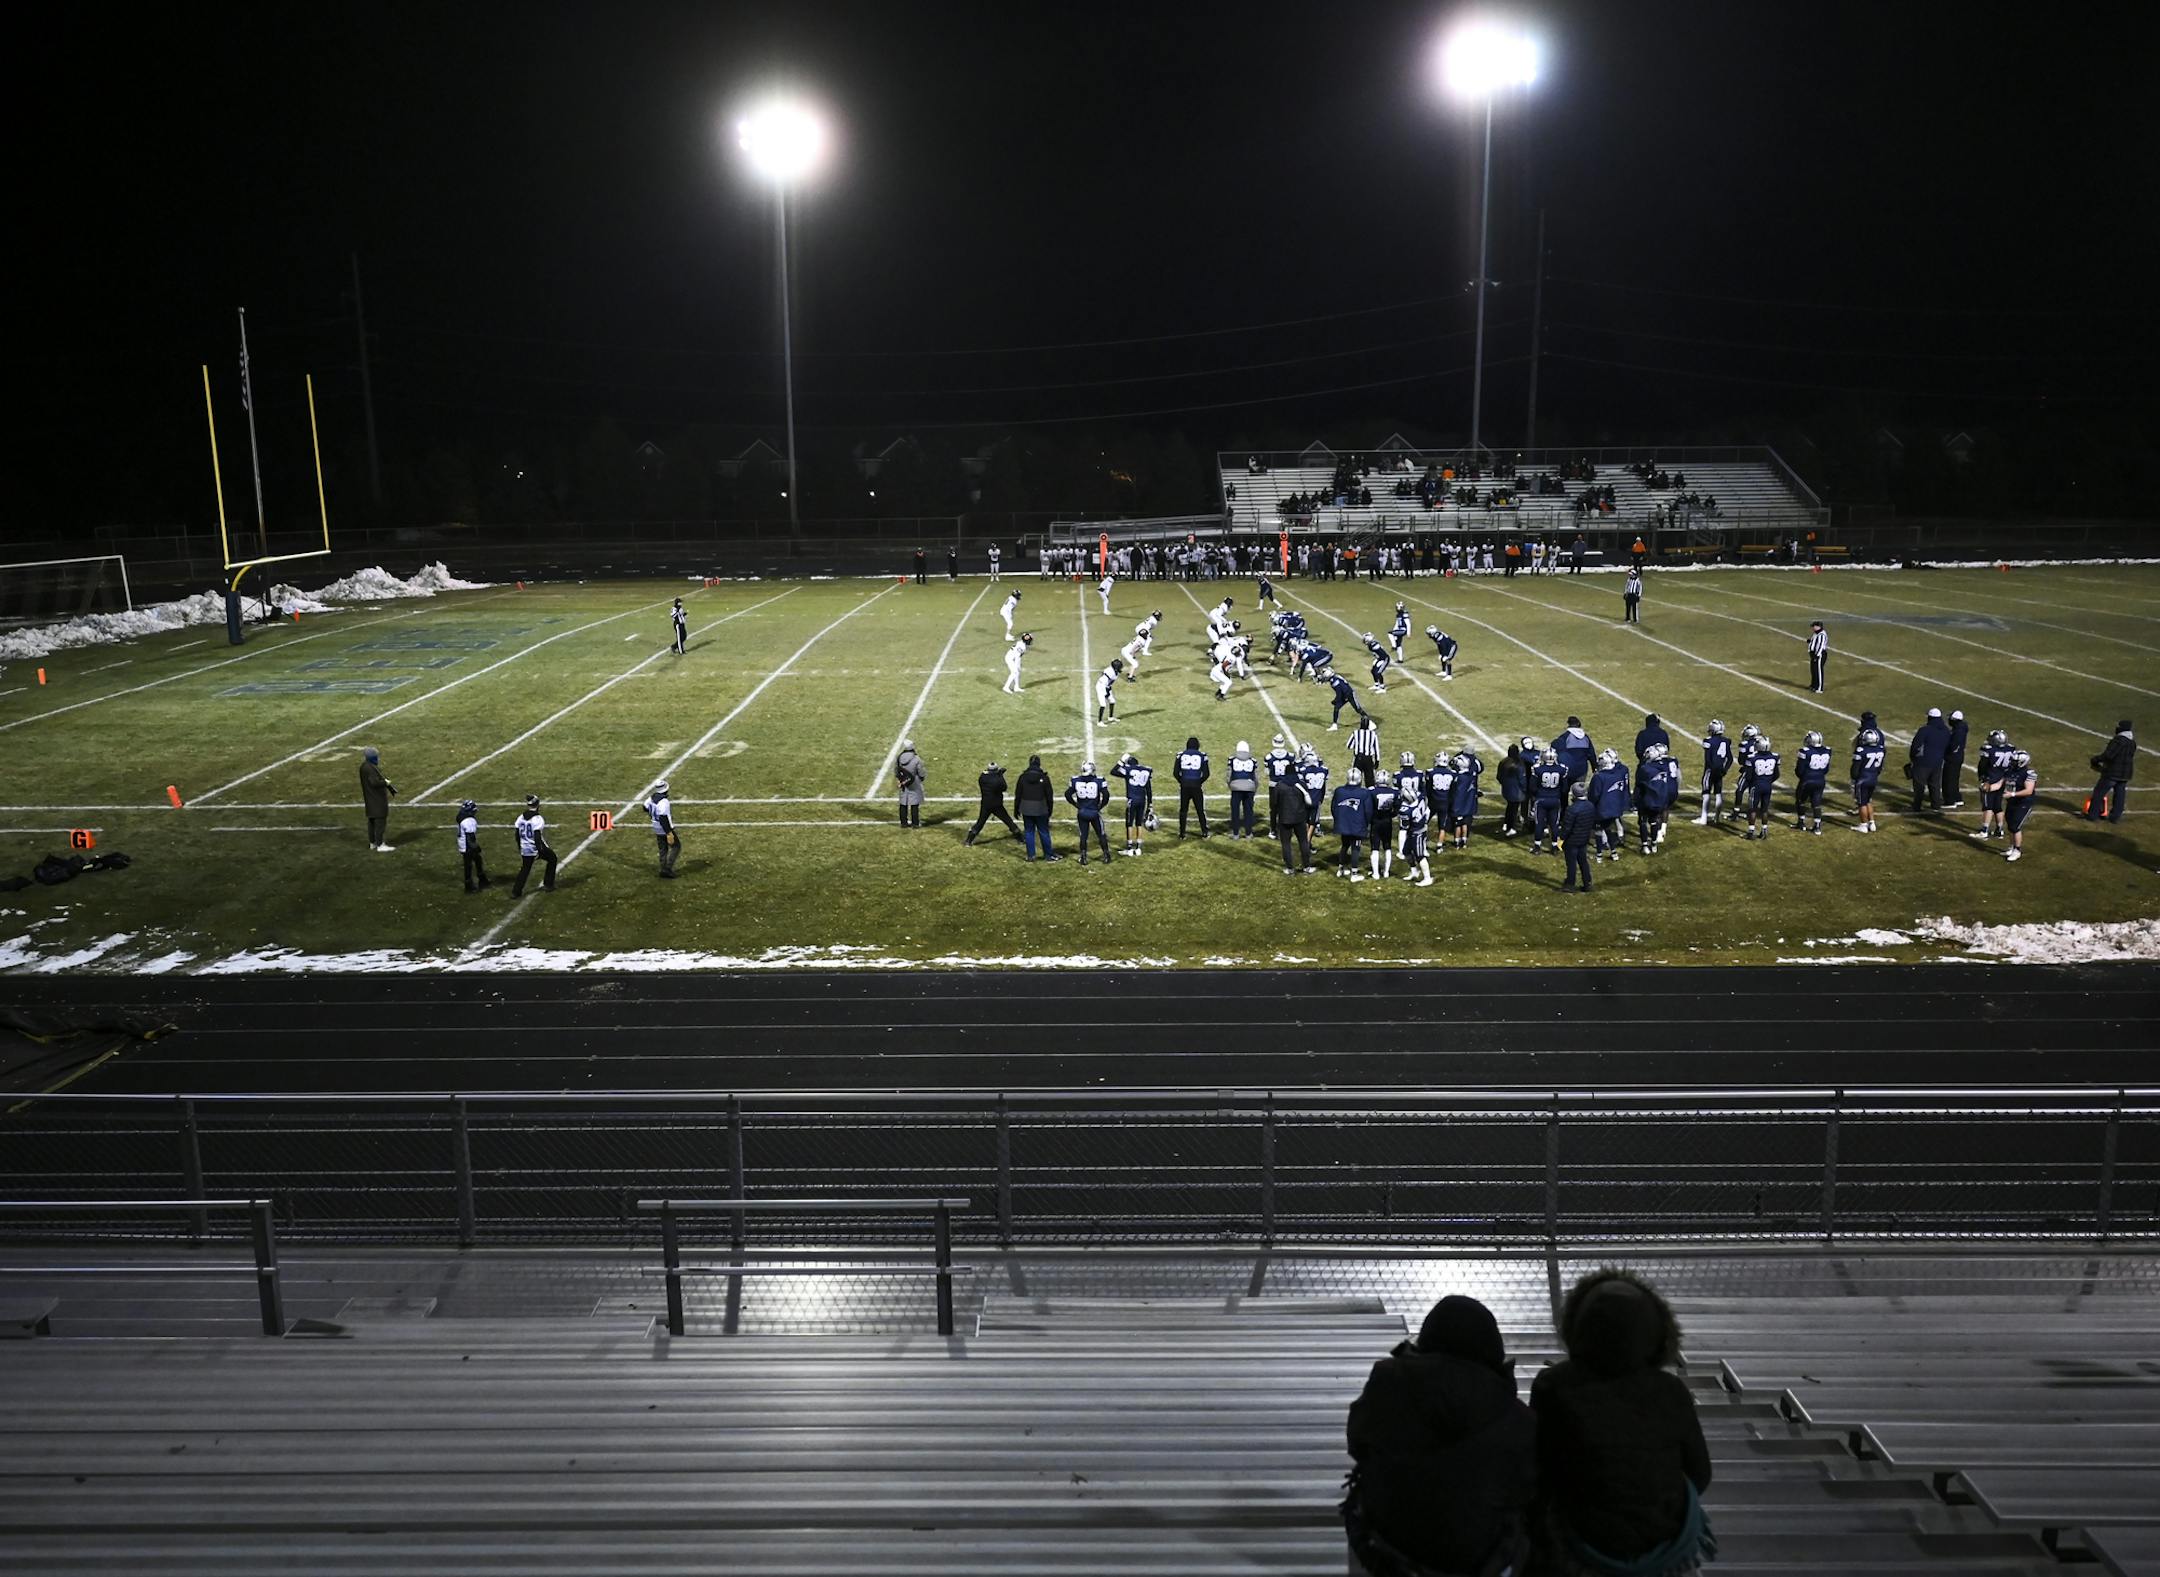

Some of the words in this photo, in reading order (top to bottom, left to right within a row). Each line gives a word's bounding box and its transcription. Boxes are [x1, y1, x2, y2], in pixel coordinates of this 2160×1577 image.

[1717, 741, 1727, 758] 4
[1128, 769, 1150, 787] 30
[1541, 771, 1560, 789] 90
[592, 813, 608, 829] 10
[520, 822, 533, 839] 28
[72, 831, 87, 848] G
